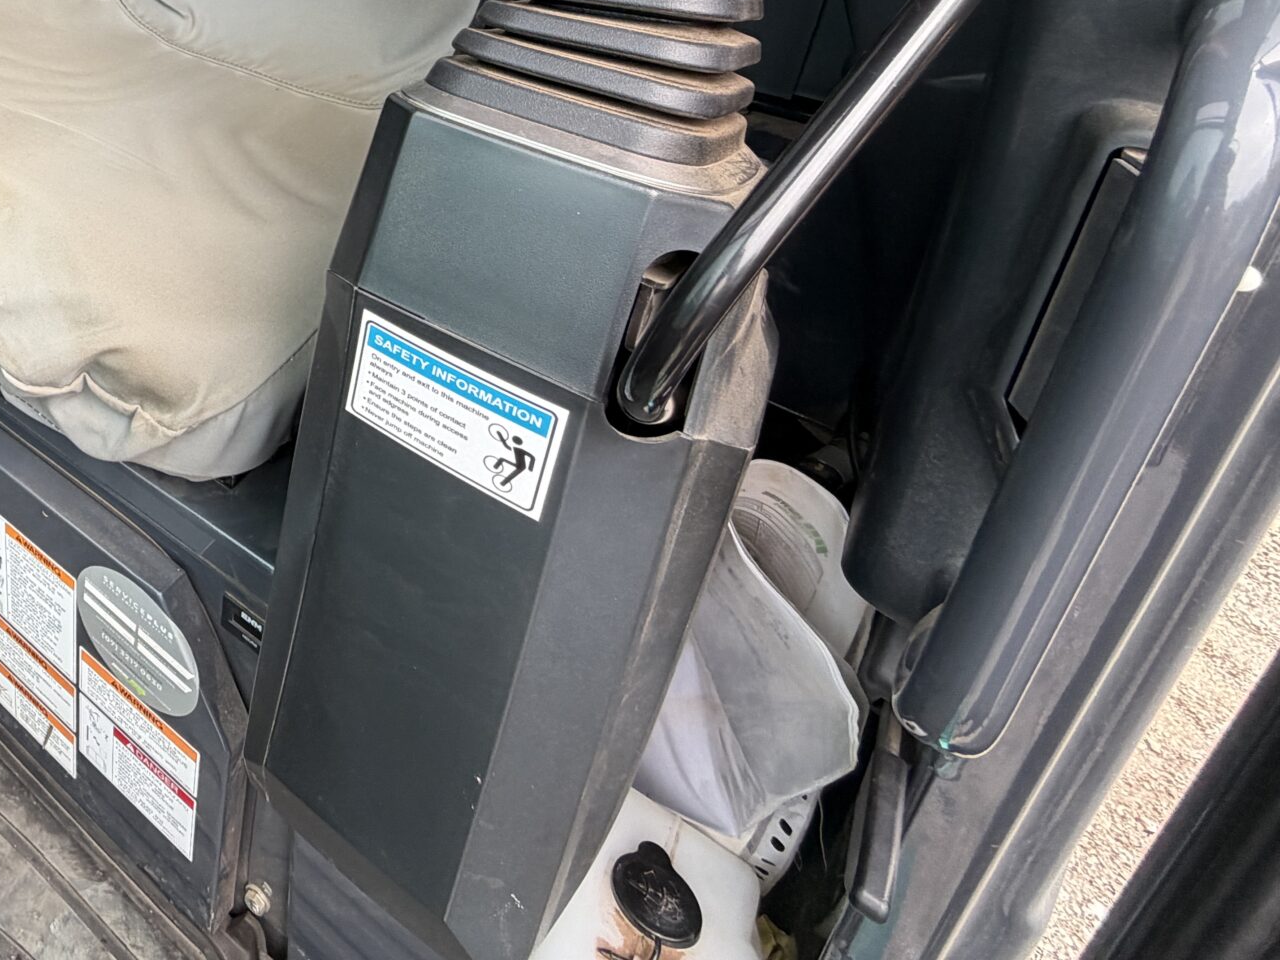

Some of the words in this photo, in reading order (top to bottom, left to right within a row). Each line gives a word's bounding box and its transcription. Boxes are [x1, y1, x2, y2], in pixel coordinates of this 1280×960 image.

[370, 361, 393, 378] always
[371, 352, 382, 363] On
[383, 360, 400, 374] entry
[402, 371, 416, 382] and
[417, 379, 430, 390] exit
[431, 386, 439, 395] to
[440, 391, 454, 403] this
[456, 400, 489, 421] machine
[373, 334, 430, 370] SAFETY
[431, 364, 543, 429] INFORMATION
[368, 389, 381, 400] and
[370, 381, 387, 395] Face
[387, 392, 417, 412] machine
[418, 410, 441, 427] during
[442, 423, 469, 441] access
[372, 371, 400, 392] Maintain
[407, 393, 428, 409] points
[430, 406, 439, 414] of
[439, 410, 466, 429] contact
[367, 397, 390, 415] Ensure
[391, 412, 402, 423] the
[403, 420, 422, 434] steps
[423, 432, 436, 442] are
[437, 439, 457, 454] clean
[385, 419, 402, 433] jump
[414, 436, 444, 458] machine
[21, 540, 62, 579] WARNING
[11, 632, 48, 671] WARNING
[13, 679, 50, 718] WARNING
[118, 687, 164, 732] WARNING
[133, 749, 180, 796] DANGER
